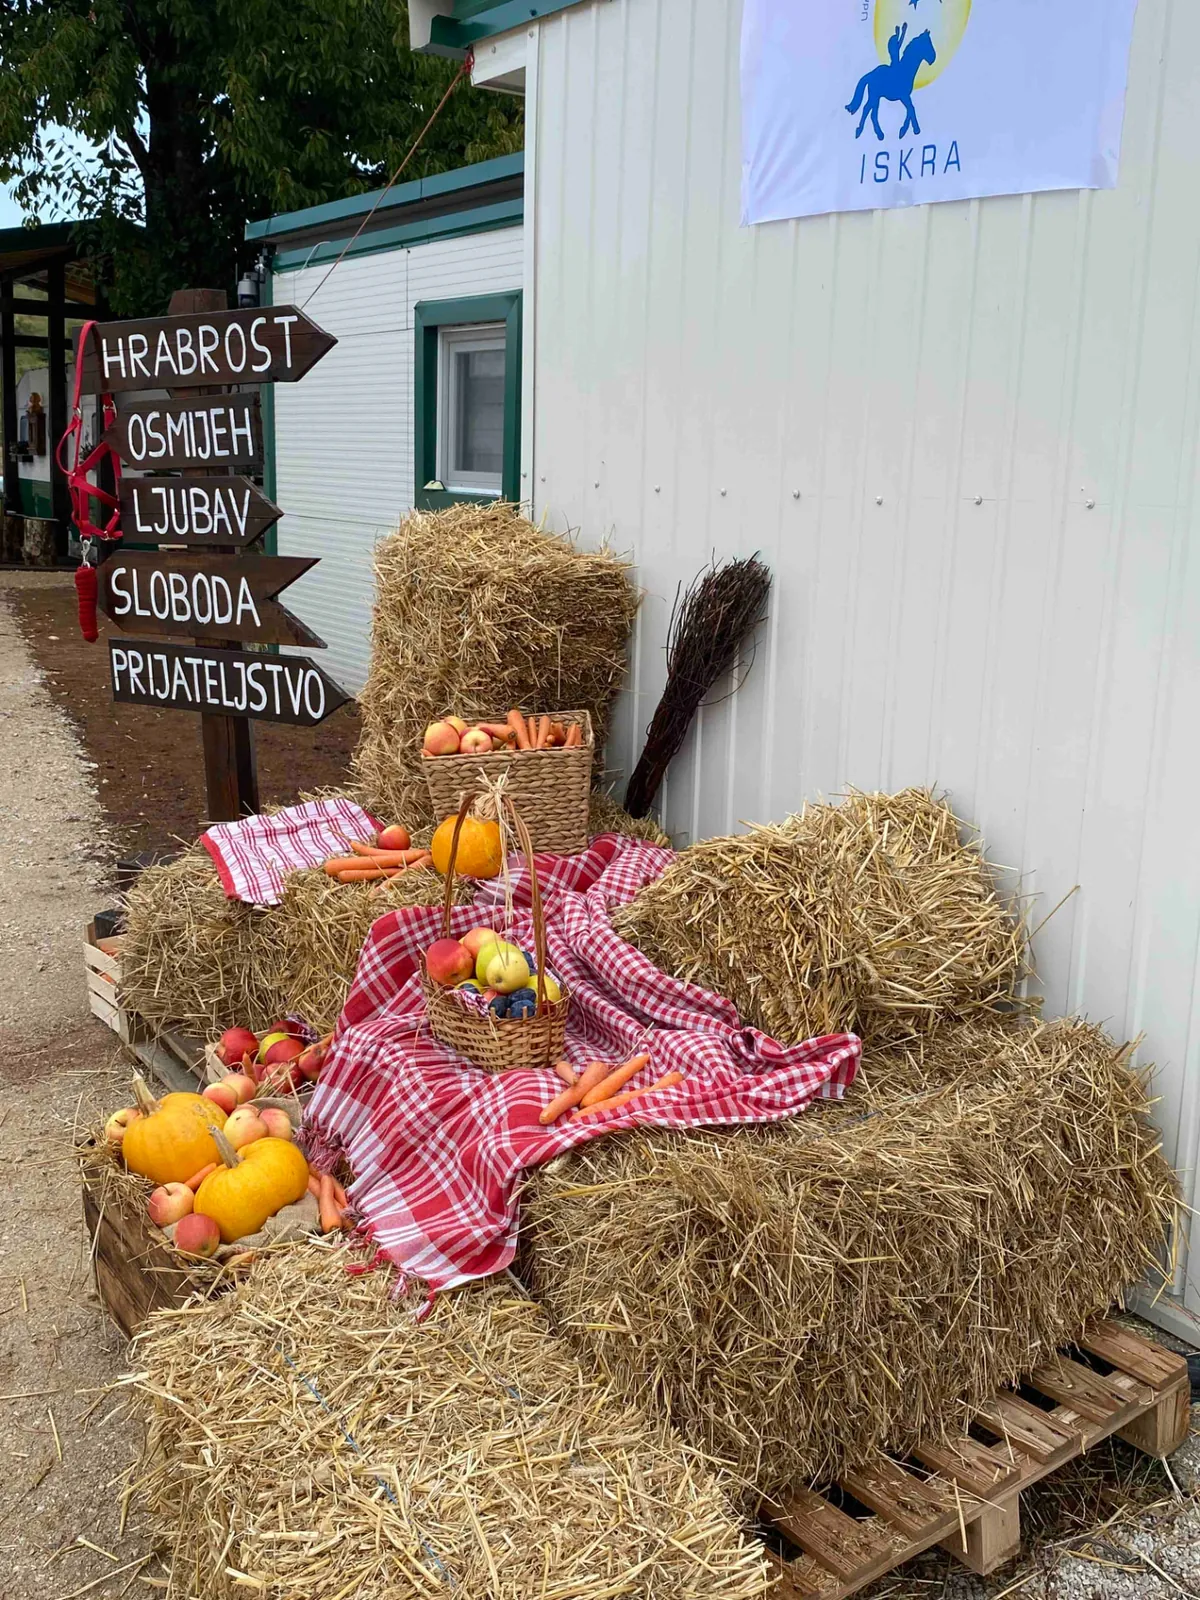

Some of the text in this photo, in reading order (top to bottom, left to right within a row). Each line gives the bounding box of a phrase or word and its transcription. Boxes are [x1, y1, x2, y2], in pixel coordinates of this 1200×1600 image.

[860, 140, 961, 184] ISKRA
[102, 316, 298, 379] HRABROST
[127, 407, 253, 460] OSMIJEH
[132, 487, 250, 536] LJUBAV
[110, 567, 261, 627] SLOBODA
[112, 648, 325, 725] PRIJATELJSTVO
